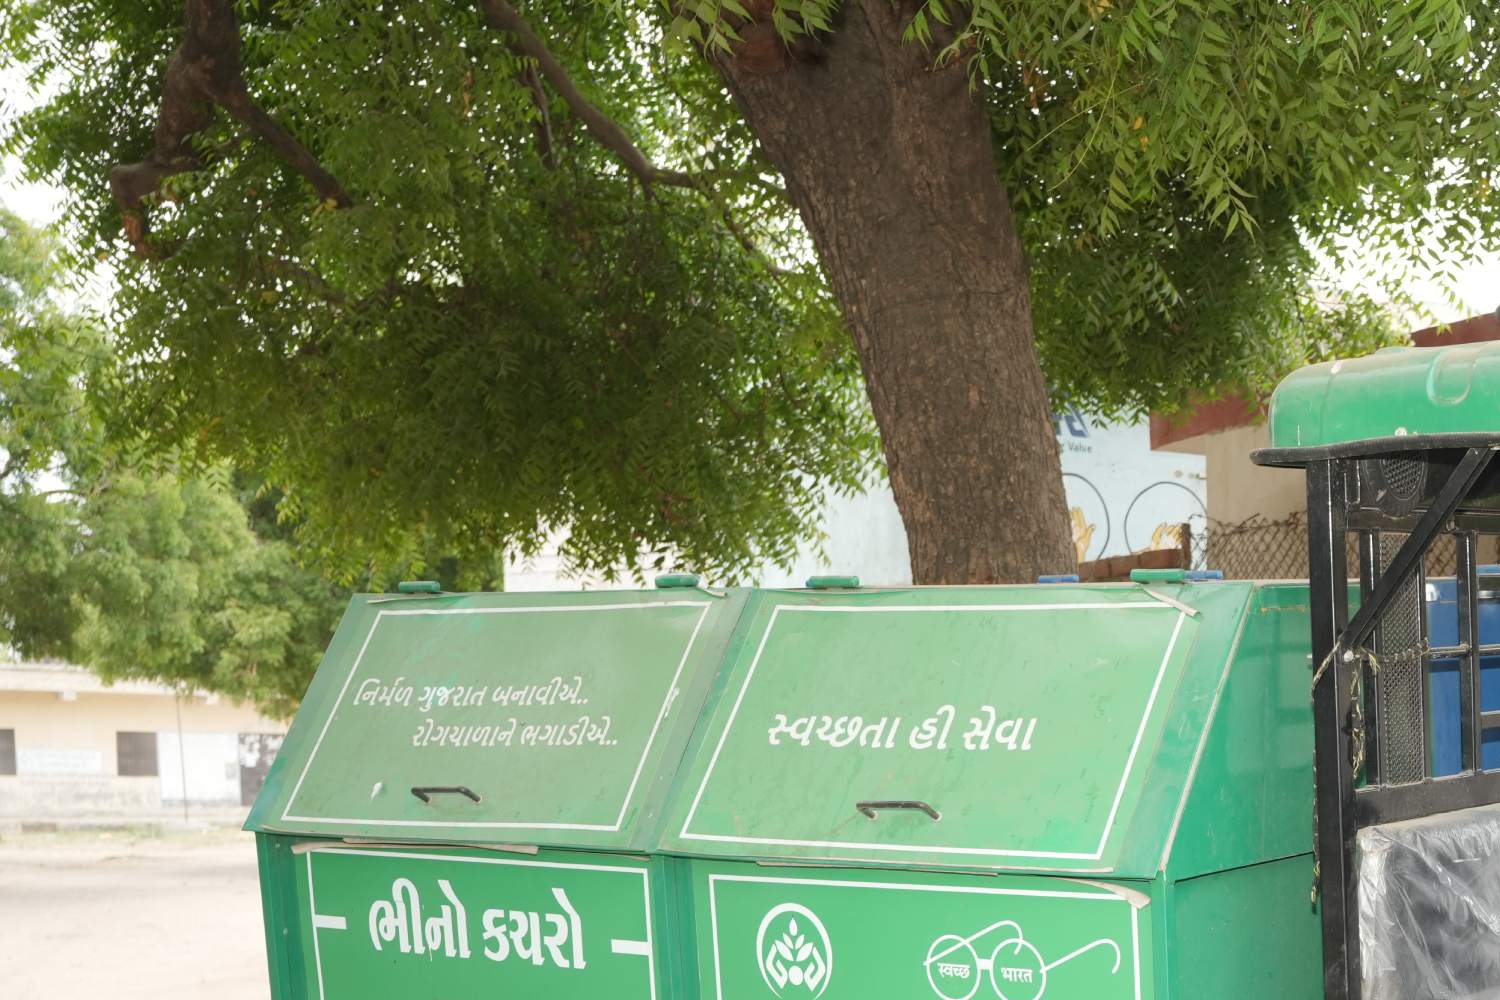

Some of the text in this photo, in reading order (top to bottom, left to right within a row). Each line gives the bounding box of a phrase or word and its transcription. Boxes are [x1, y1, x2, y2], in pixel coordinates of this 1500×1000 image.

[417, 685, 488, 713] ગુજરાત
[767, 704, 1037, 751] સ્વચ્છતા હી સેવા
[368, 877, 587, 970] ભીનો કચરો
[1000, 967, 1033, 983] भारत
